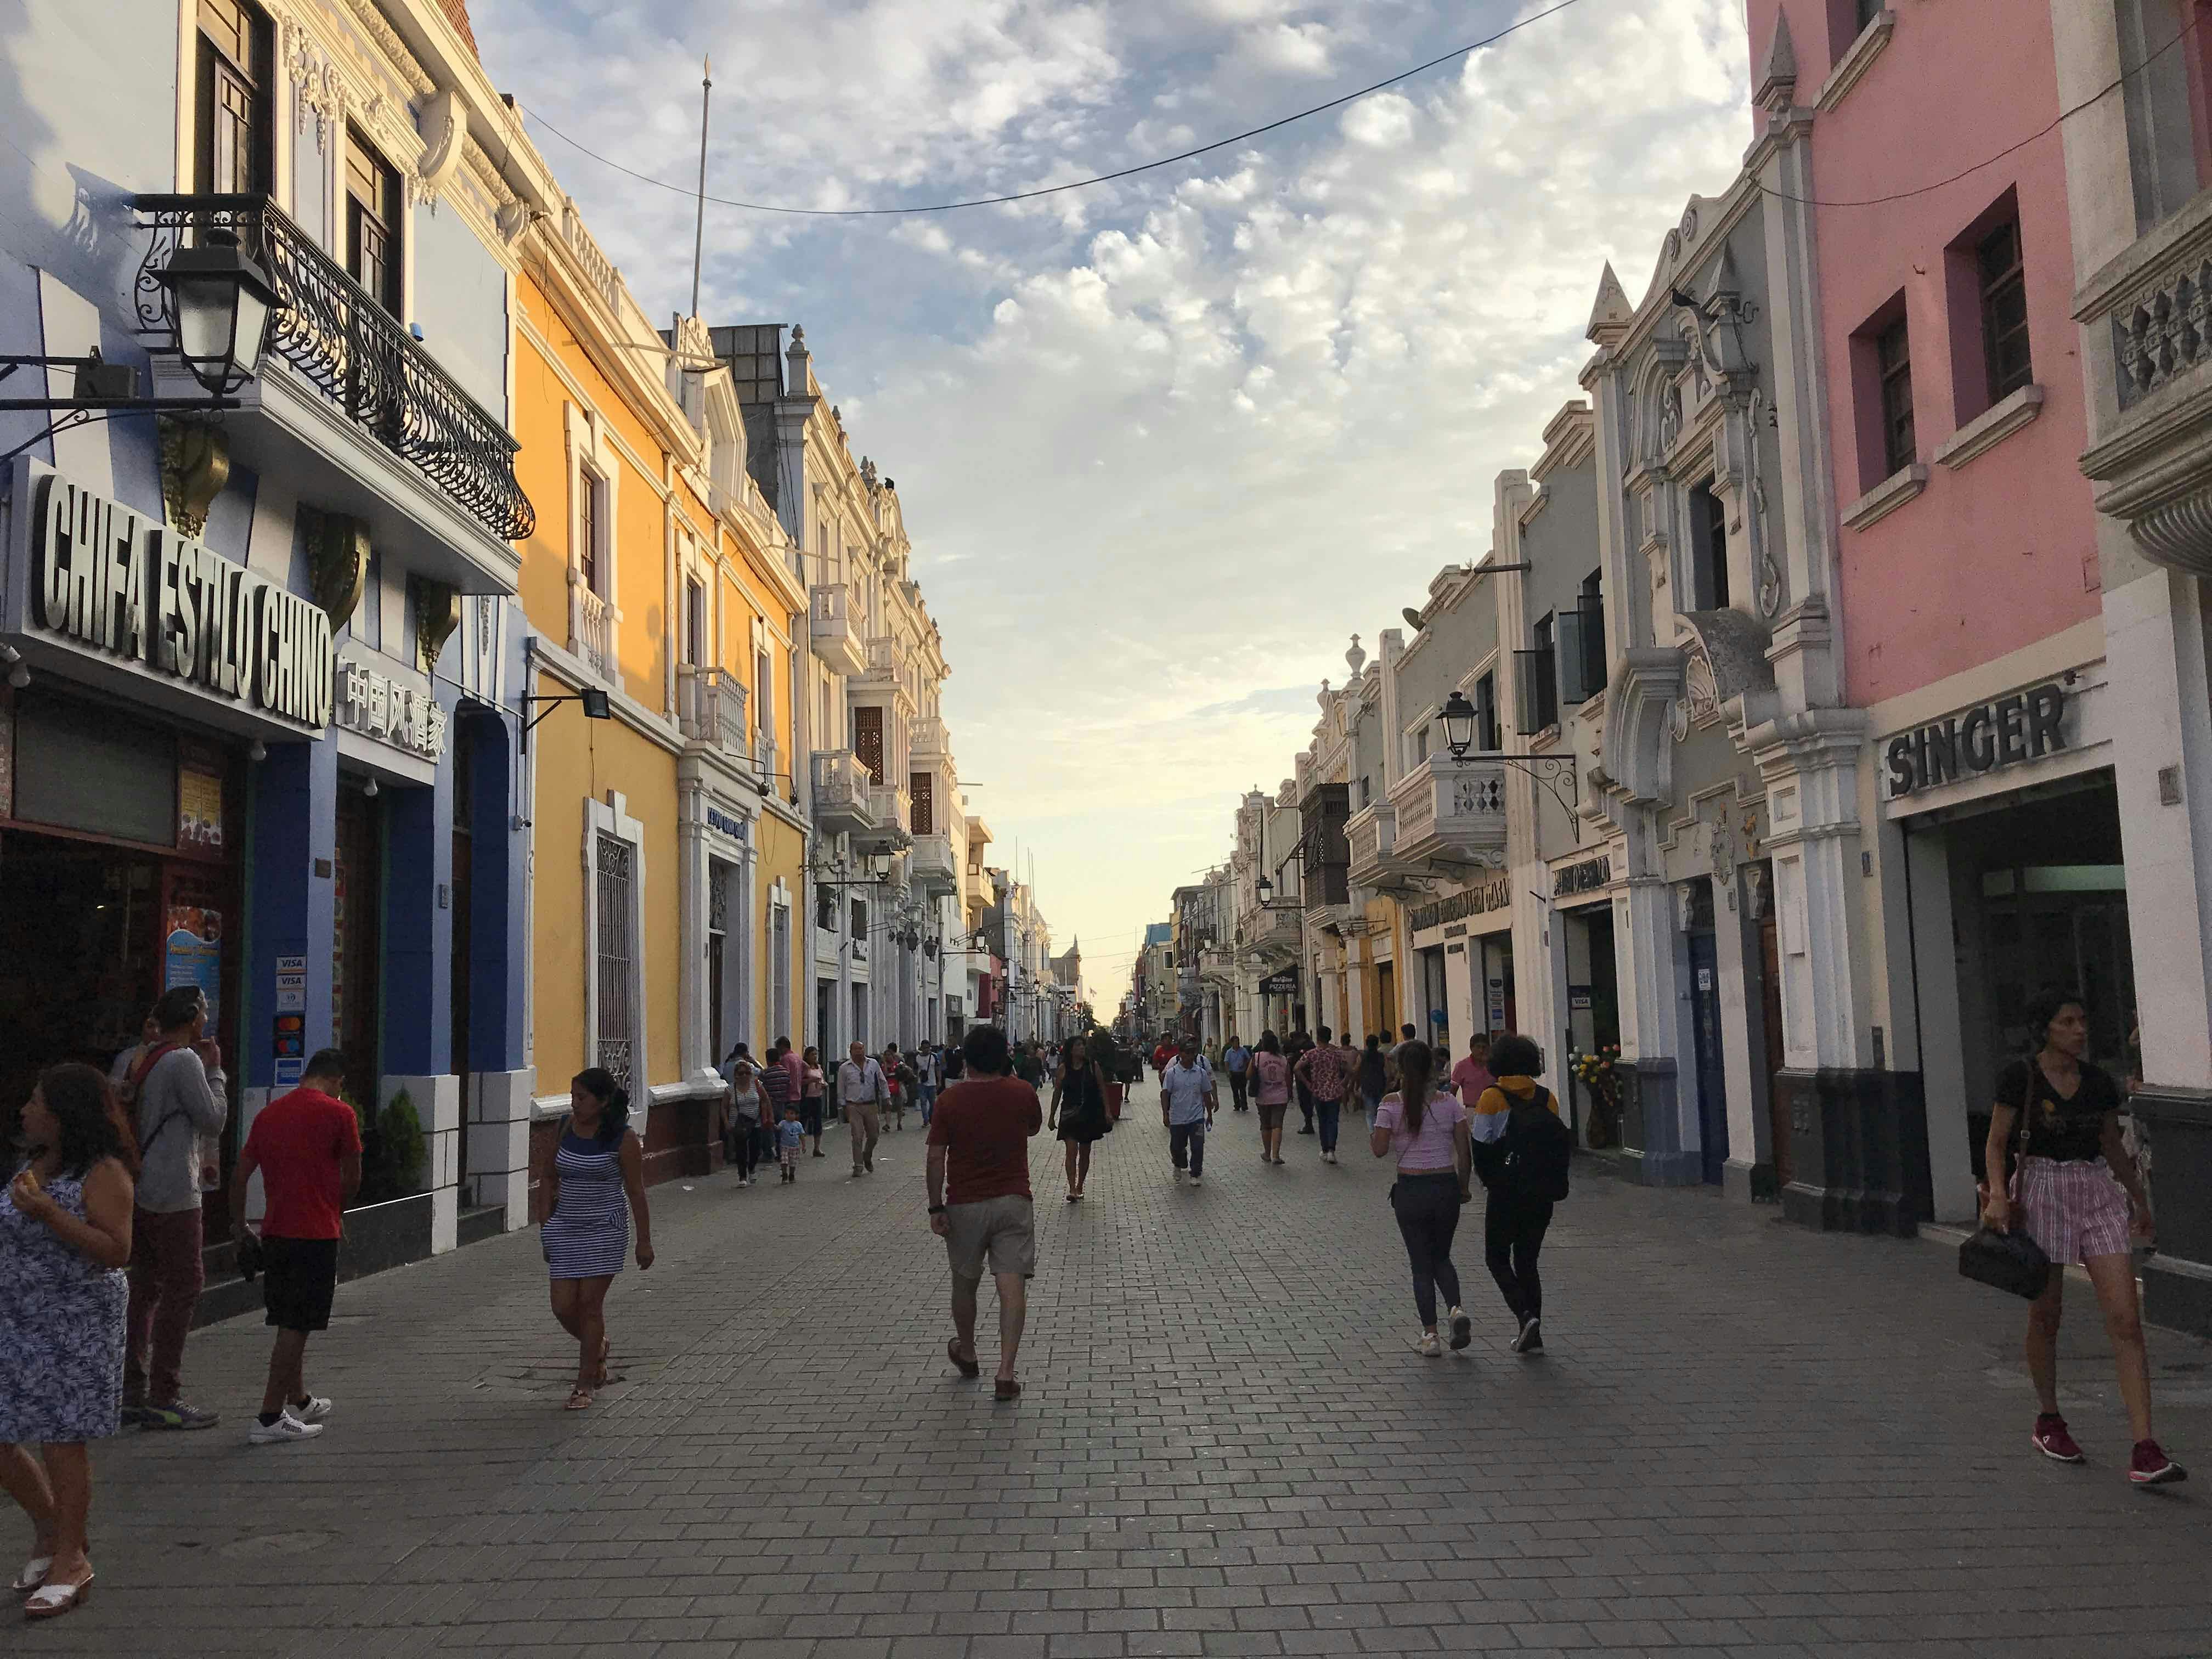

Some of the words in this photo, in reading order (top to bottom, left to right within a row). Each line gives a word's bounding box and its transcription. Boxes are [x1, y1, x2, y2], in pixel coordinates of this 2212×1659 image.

[44, 474, 146, 661] CHIFA
[157, 530, 254, 699] ESTILO
[261, 585, 331, 729] CHINO
[347, 662, 447, 756] 中国风酒家
[1888, 684, 2067, 796] SINGER
